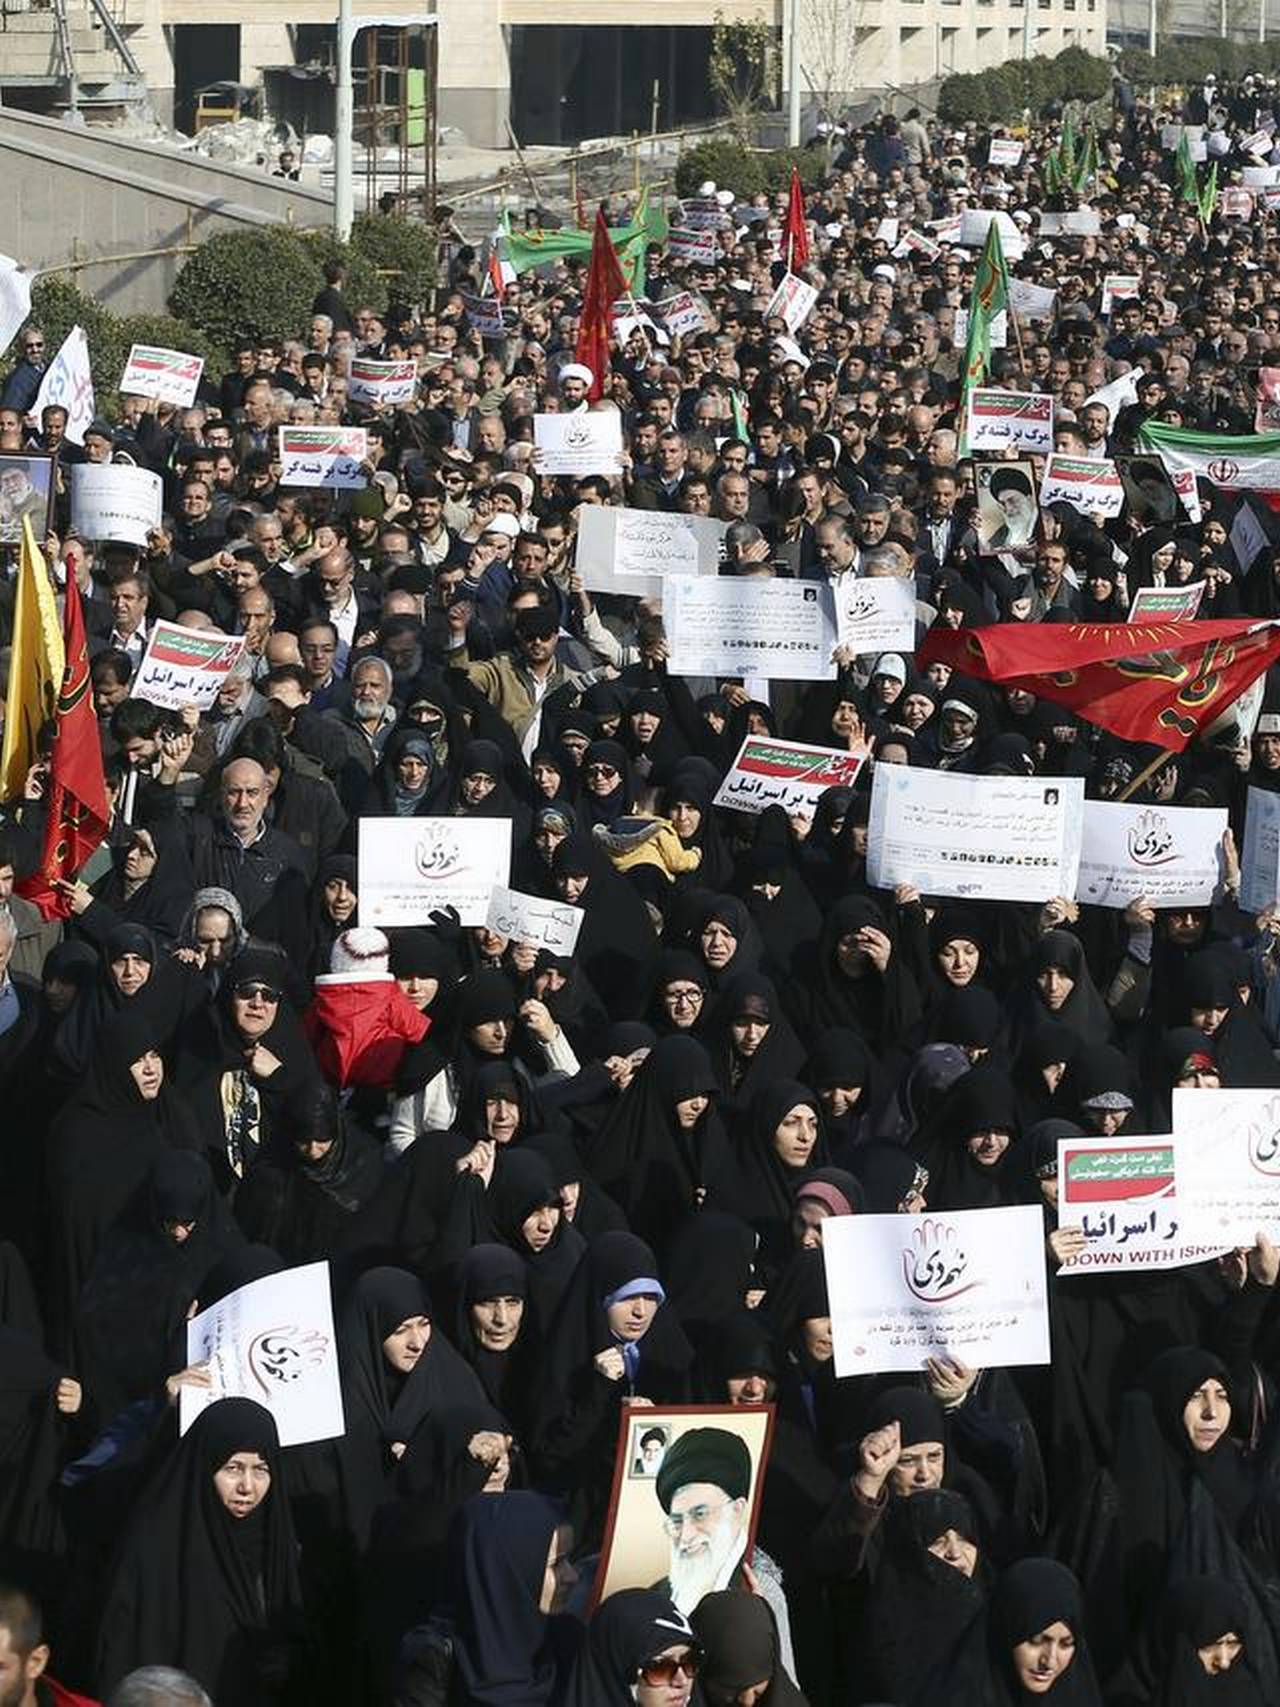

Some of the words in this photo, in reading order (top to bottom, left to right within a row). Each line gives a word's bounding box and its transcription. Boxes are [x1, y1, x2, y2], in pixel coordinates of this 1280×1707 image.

[728, 777, 788, 800] اسرائیل
[786, 793, 803, 808] بر
[912, 1248, 945, 1288] دی
[1066, 1252, 1123, 1267] DOWN
[1128, 1249, 1174, 1263] WITH
[936, 1247, 969, 1294] نهم
